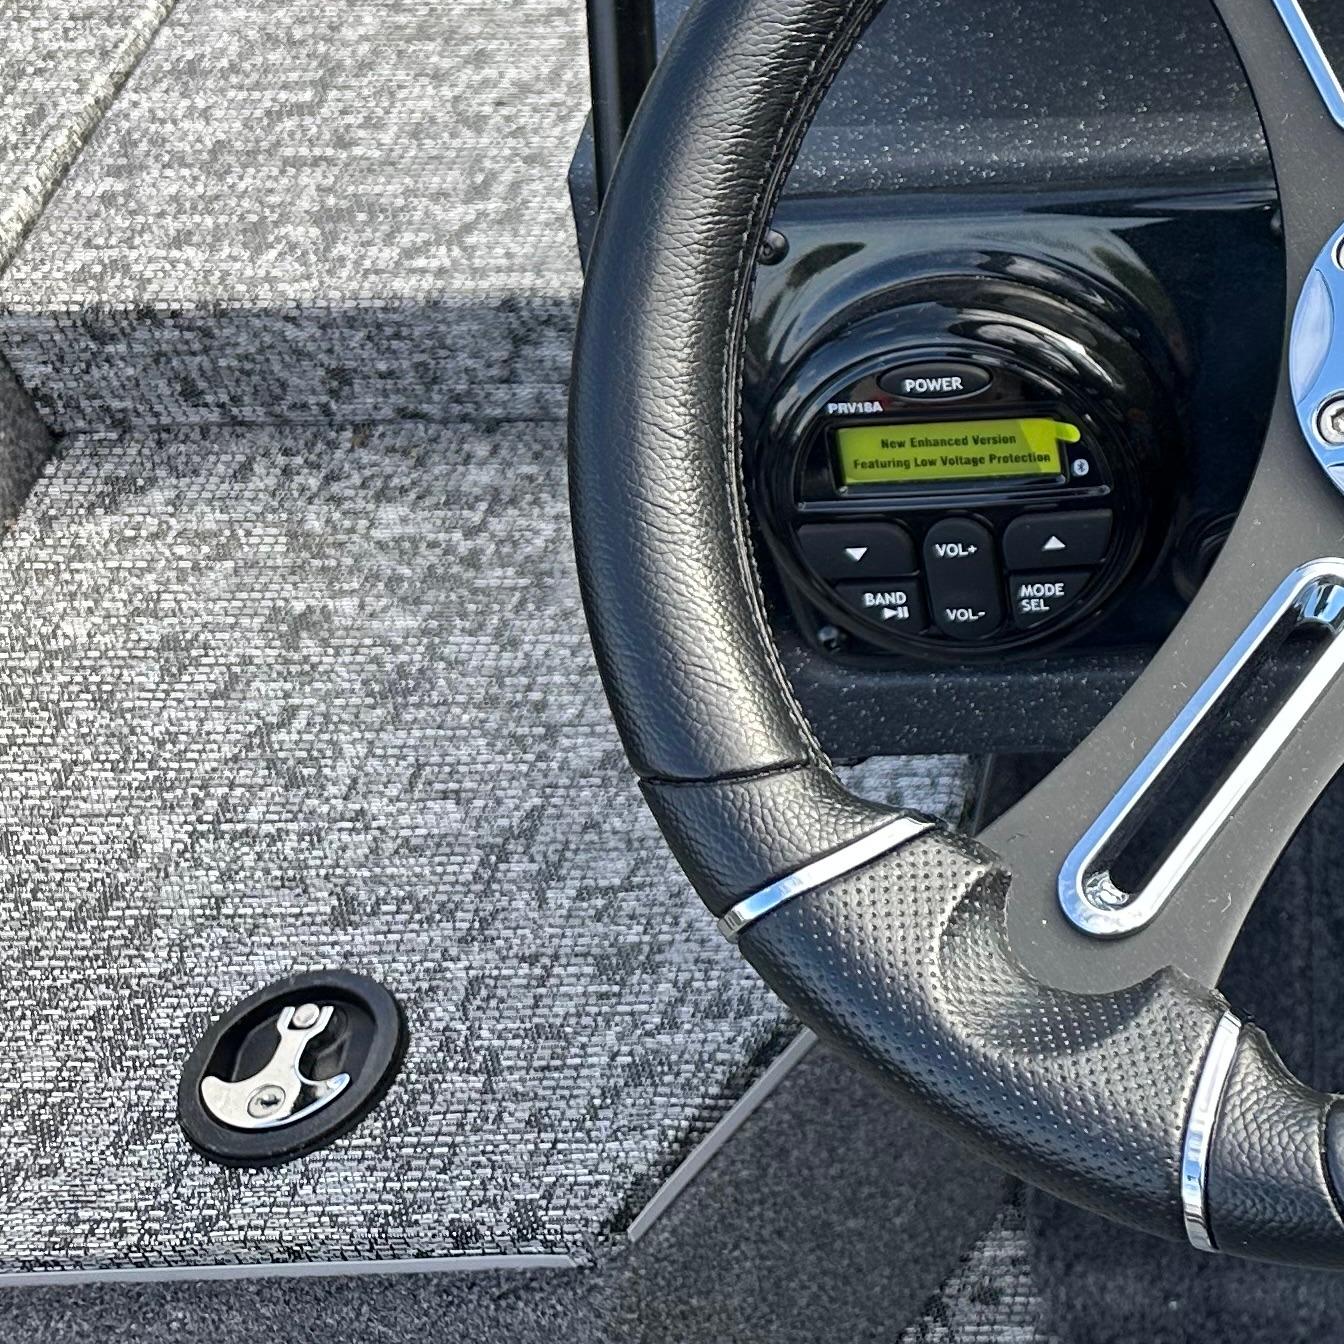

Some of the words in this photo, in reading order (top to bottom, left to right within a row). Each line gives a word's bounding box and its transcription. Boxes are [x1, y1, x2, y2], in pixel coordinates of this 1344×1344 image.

[905, 376, 964, 393] POWER
[880, 438, 906, 450] New
[910, 435, 969, 449] Enhanced
[972, 434, 1017, 446] Version
[853, 456, 911, 470] Featuring
[914, 456, 938, 468] Low
[941, 454, 986, 469] Voltage
[989, 451, 1051, 465] Protection
[935, 542, 978, 558] VOL+
[1020, 583, 1065, 598] MODE
[864, 592, 907, 606] BAND
[1021, 598, 1050, 613] SEL
[945, 607, 986, 623] VOL-
